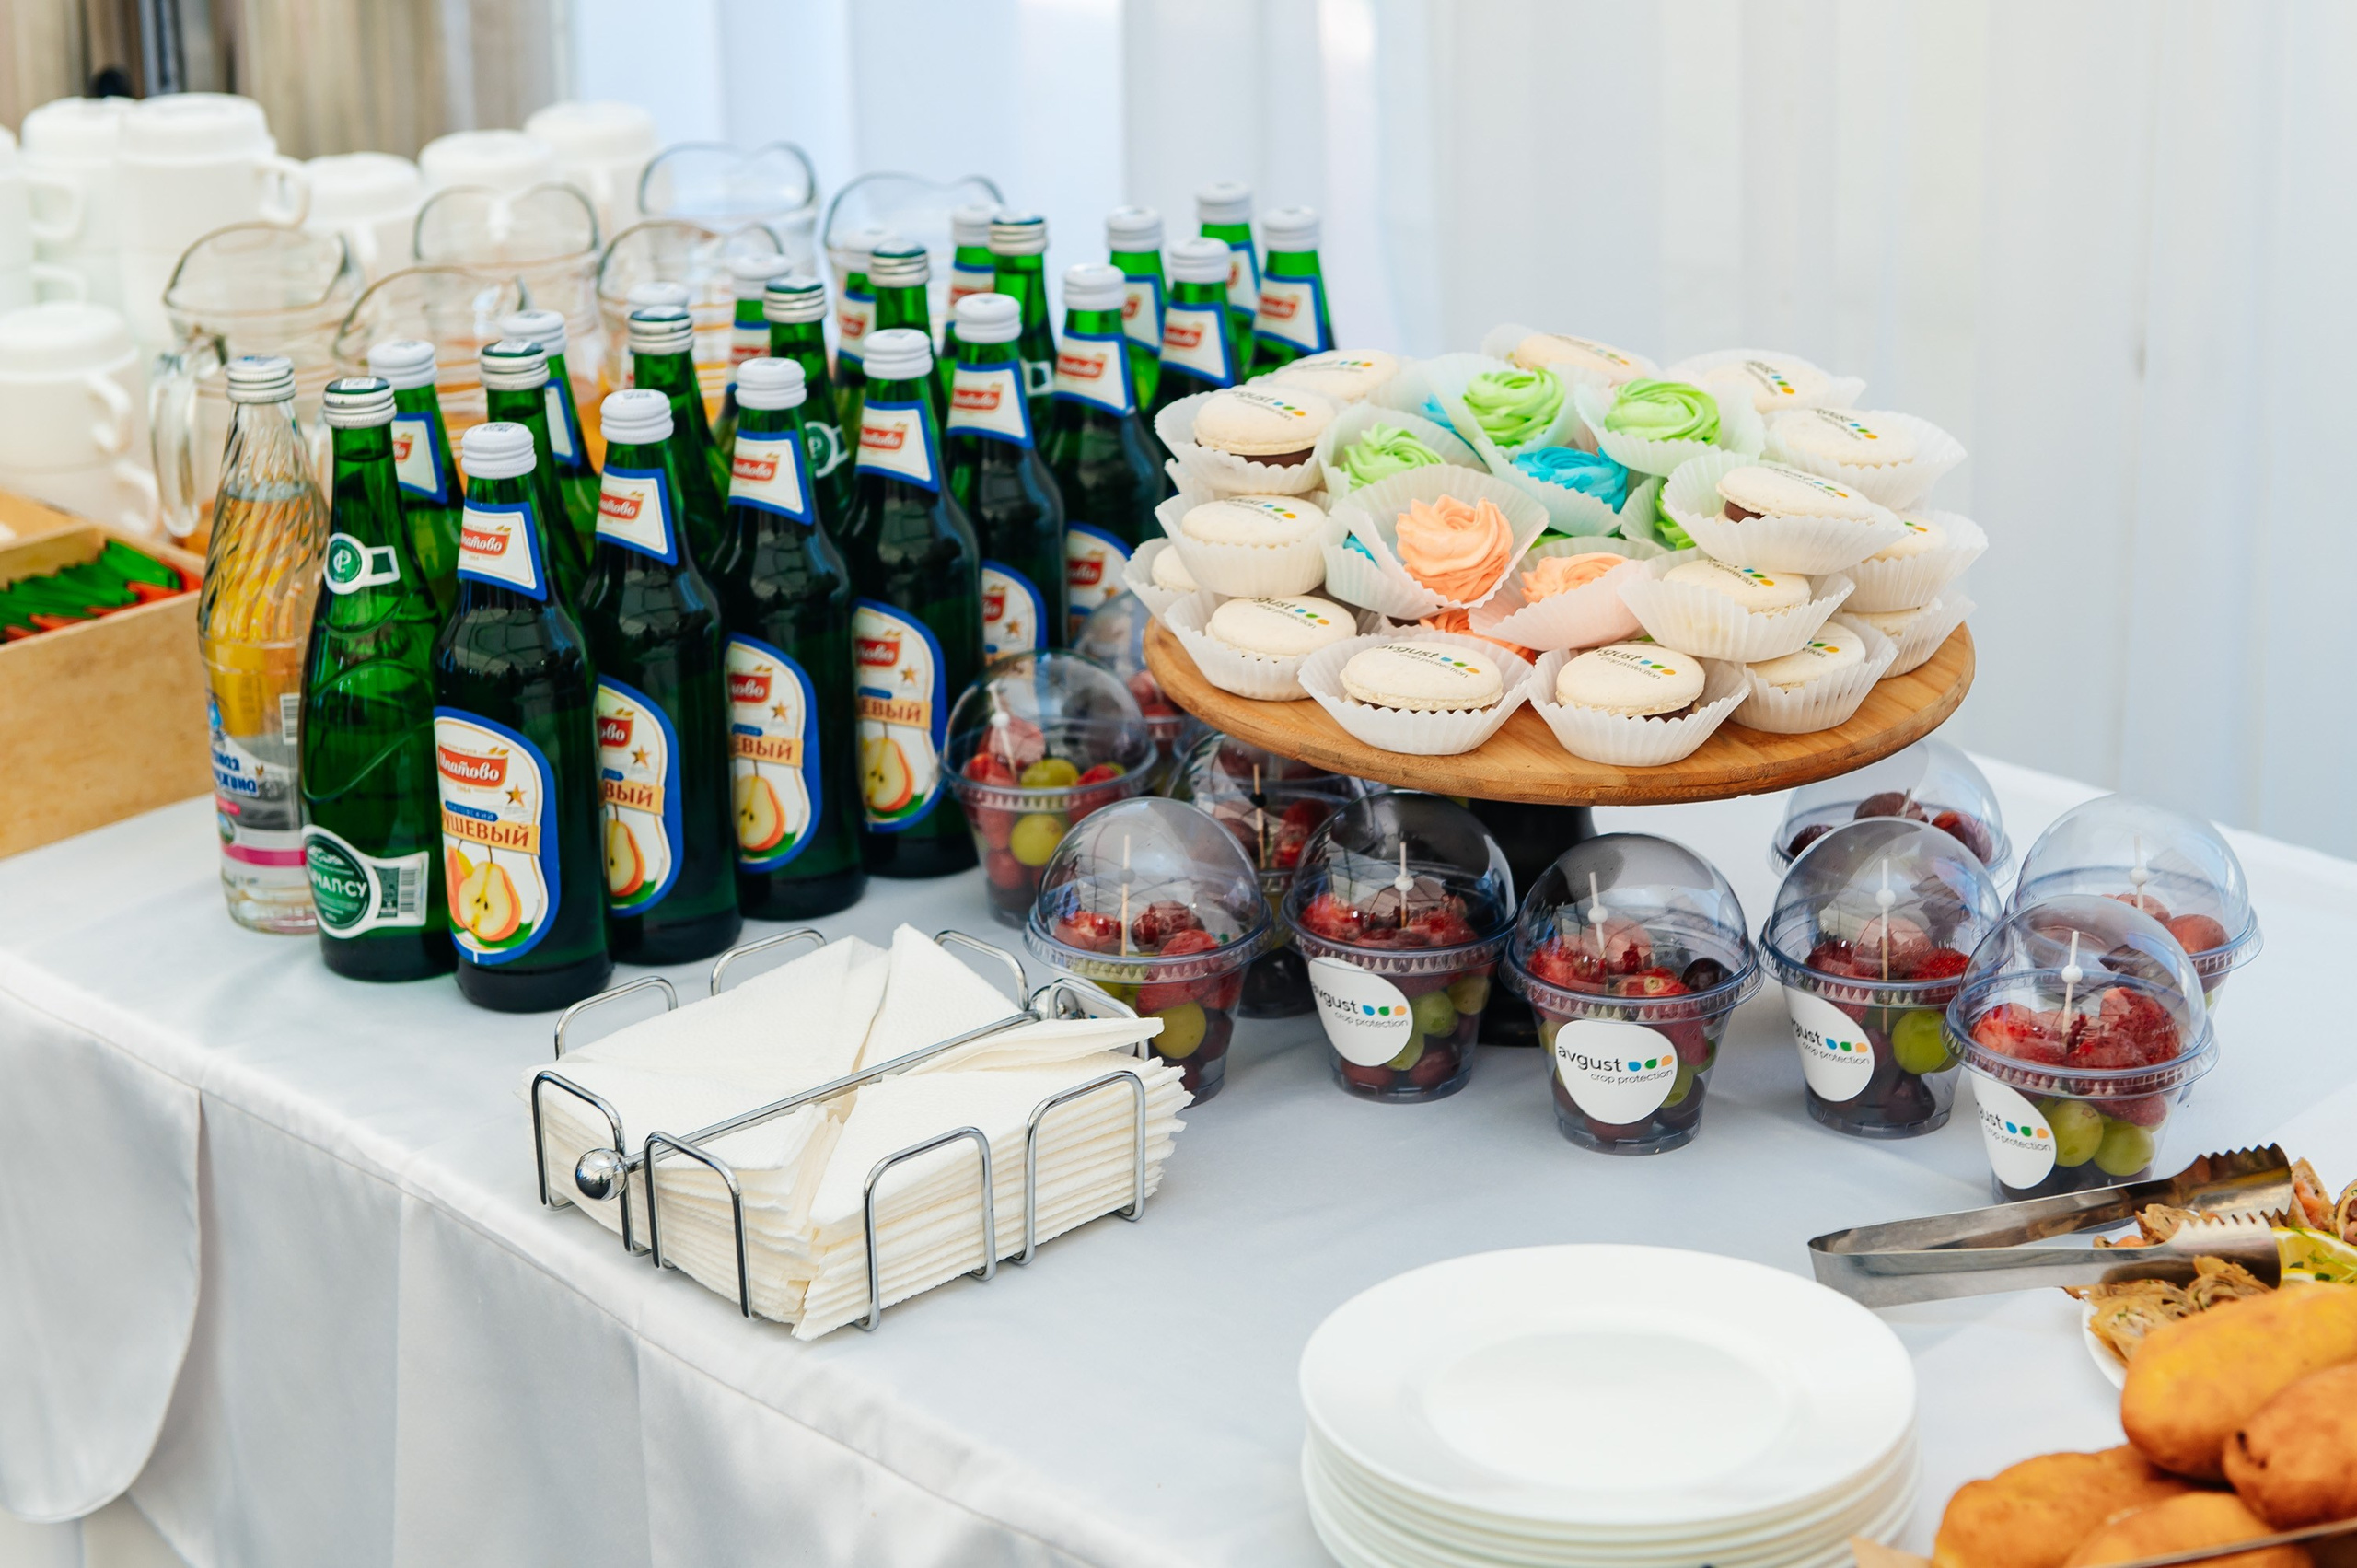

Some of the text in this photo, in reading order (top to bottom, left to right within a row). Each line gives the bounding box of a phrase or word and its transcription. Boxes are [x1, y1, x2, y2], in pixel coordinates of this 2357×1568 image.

[1335, 1012, 1409, 1028] crop protection
[1558, 1045, 1622, 1074] avgust
[1819, 1050, 1871, 1065] protection
[1590, 1069, 1674, 1085] crop protection
[2001, 1135, 2052, 1152] protection
